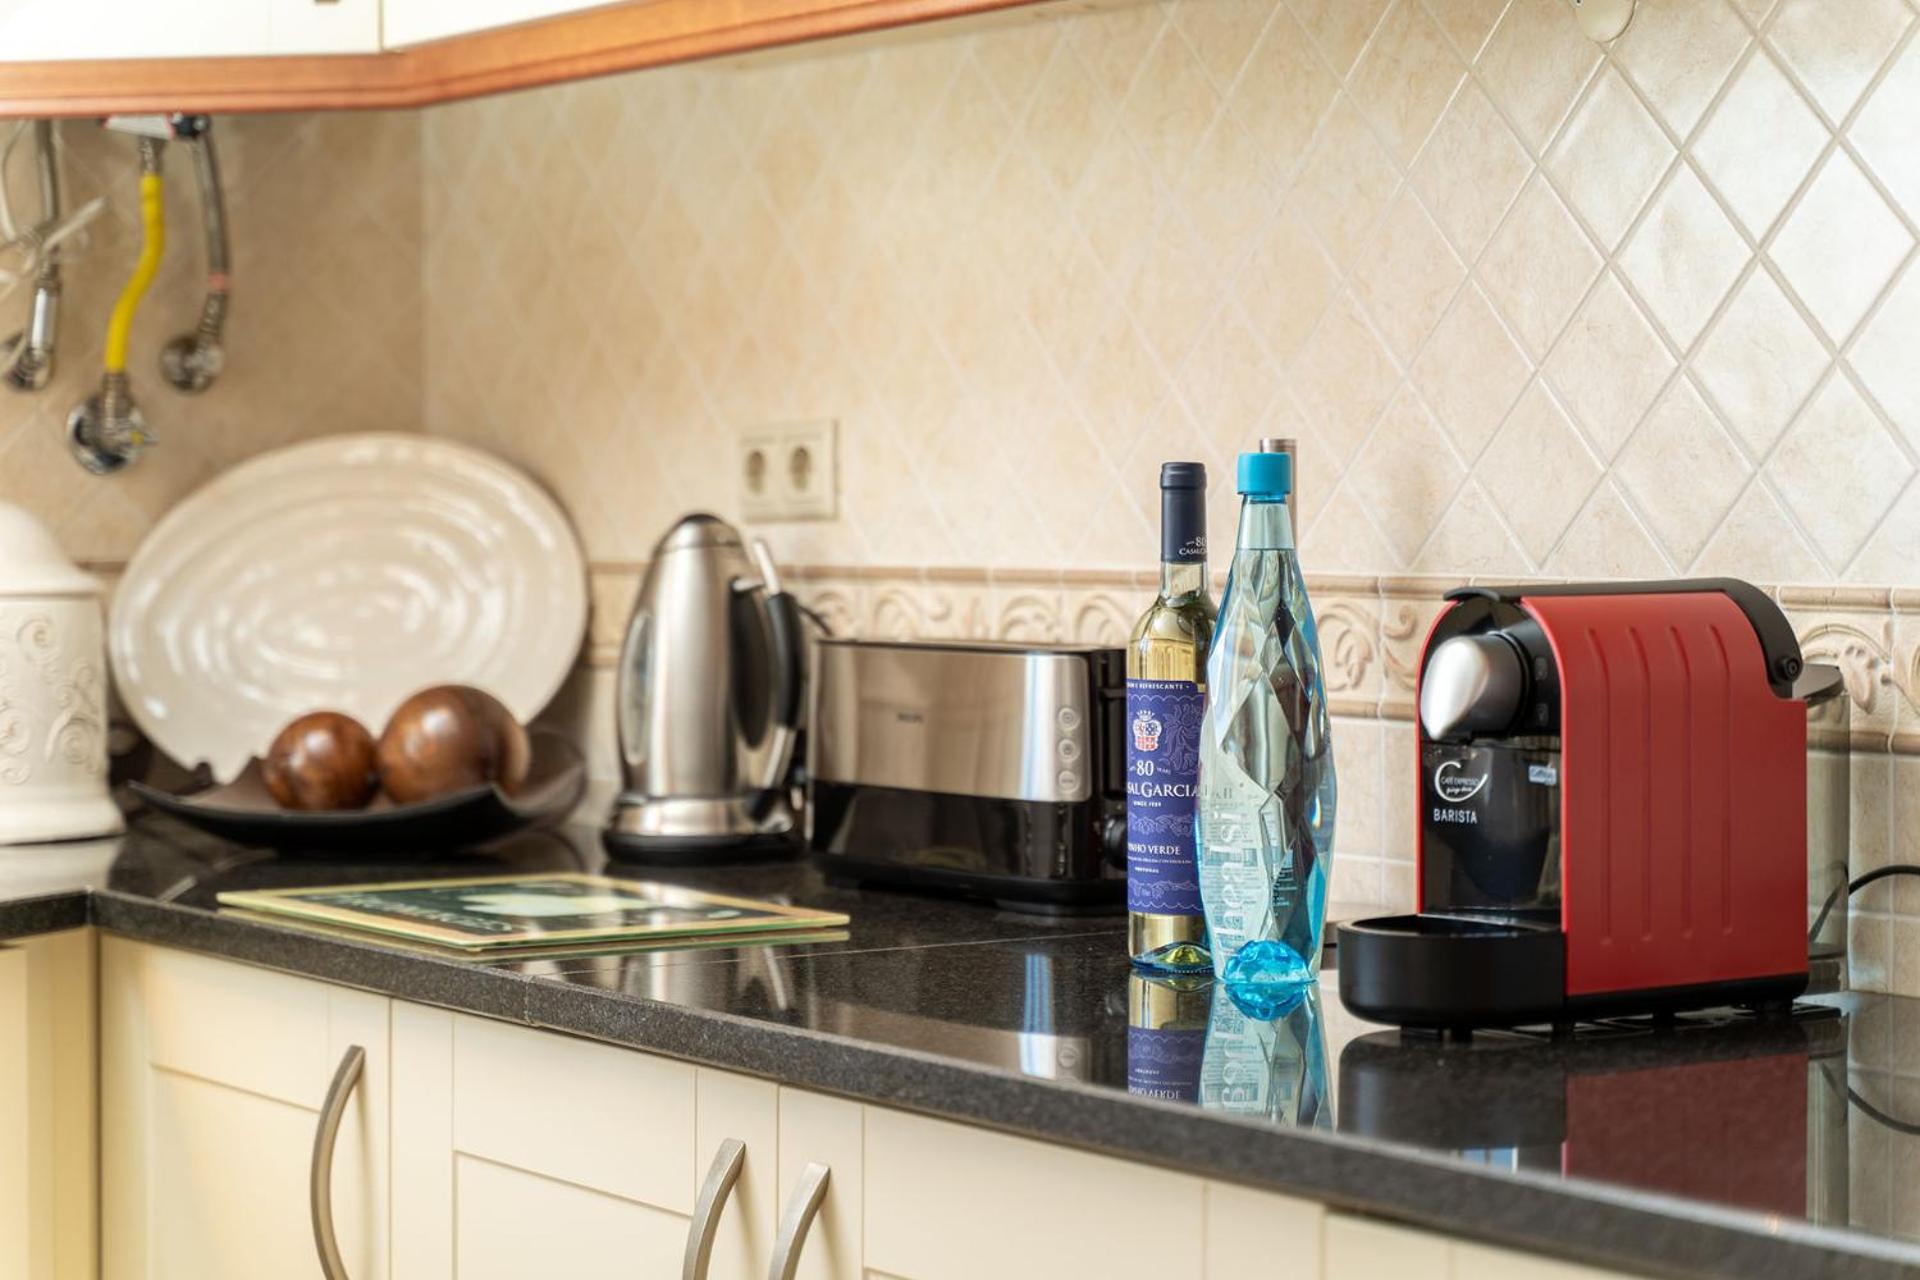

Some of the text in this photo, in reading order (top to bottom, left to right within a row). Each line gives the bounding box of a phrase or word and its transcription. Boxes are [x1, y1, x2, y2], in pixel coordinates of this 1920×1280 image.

[1136, 760, 1154, 777] 80
[1433, 808, 1478, 824] BARISTA
[1148, 845, 1181, 856] VERDE
